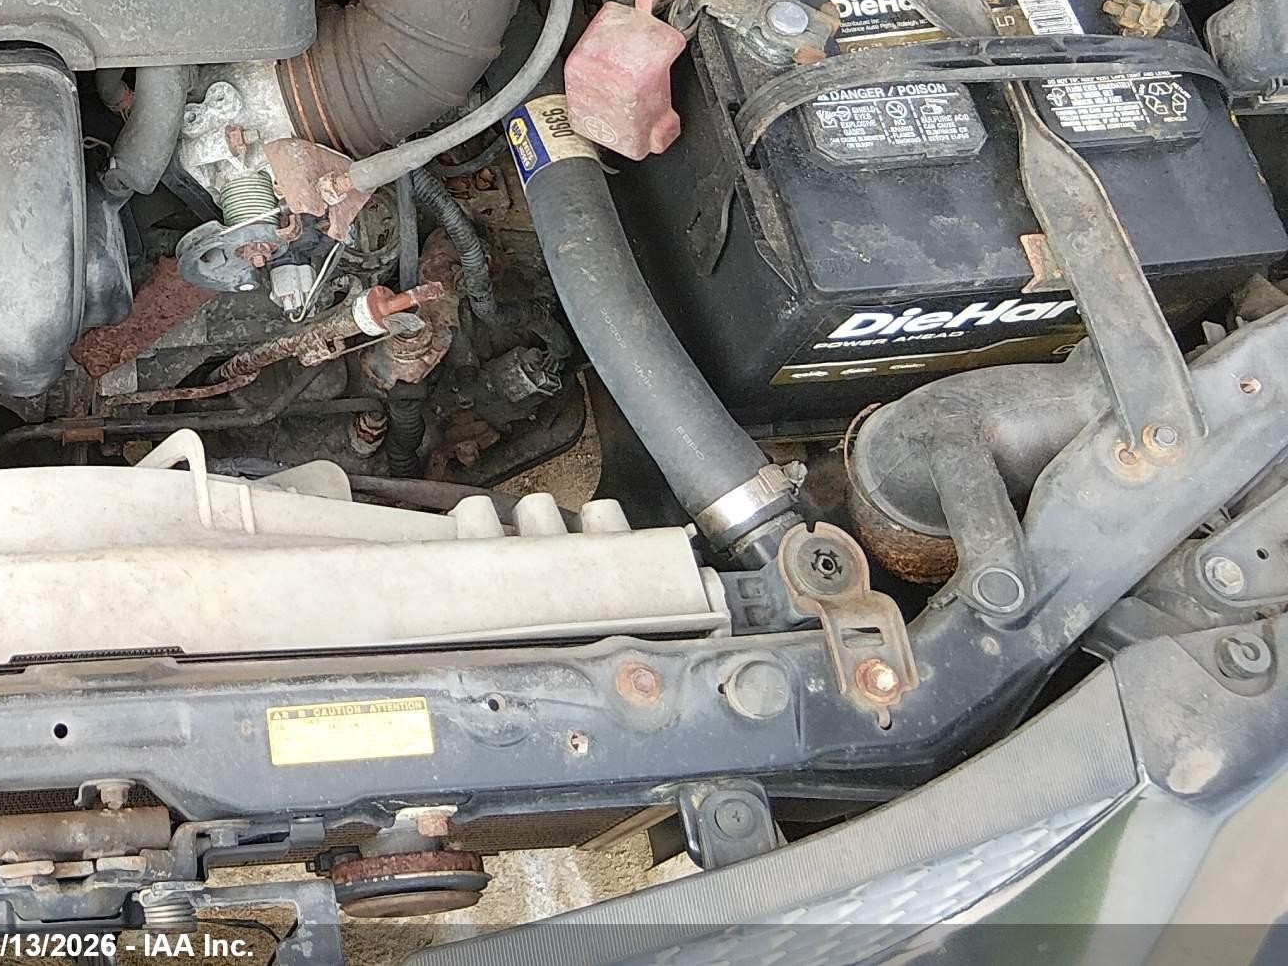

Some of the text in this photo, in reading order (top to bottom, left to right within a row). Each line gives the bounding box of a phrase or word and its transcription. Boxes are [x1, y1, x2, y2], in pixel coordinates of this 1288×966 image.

[830, 87, 885, 101] DANGER
[898, 83, 948, 95] POISON
[542, 107, 576, 139] 9390
[828, 299, 1078, 339] DieHar
[813, 331, 964, 350] POWER AHEAD
[312, 706, 361, 717] CAUTION
[369, 701, 423, 713] ATTENTION
